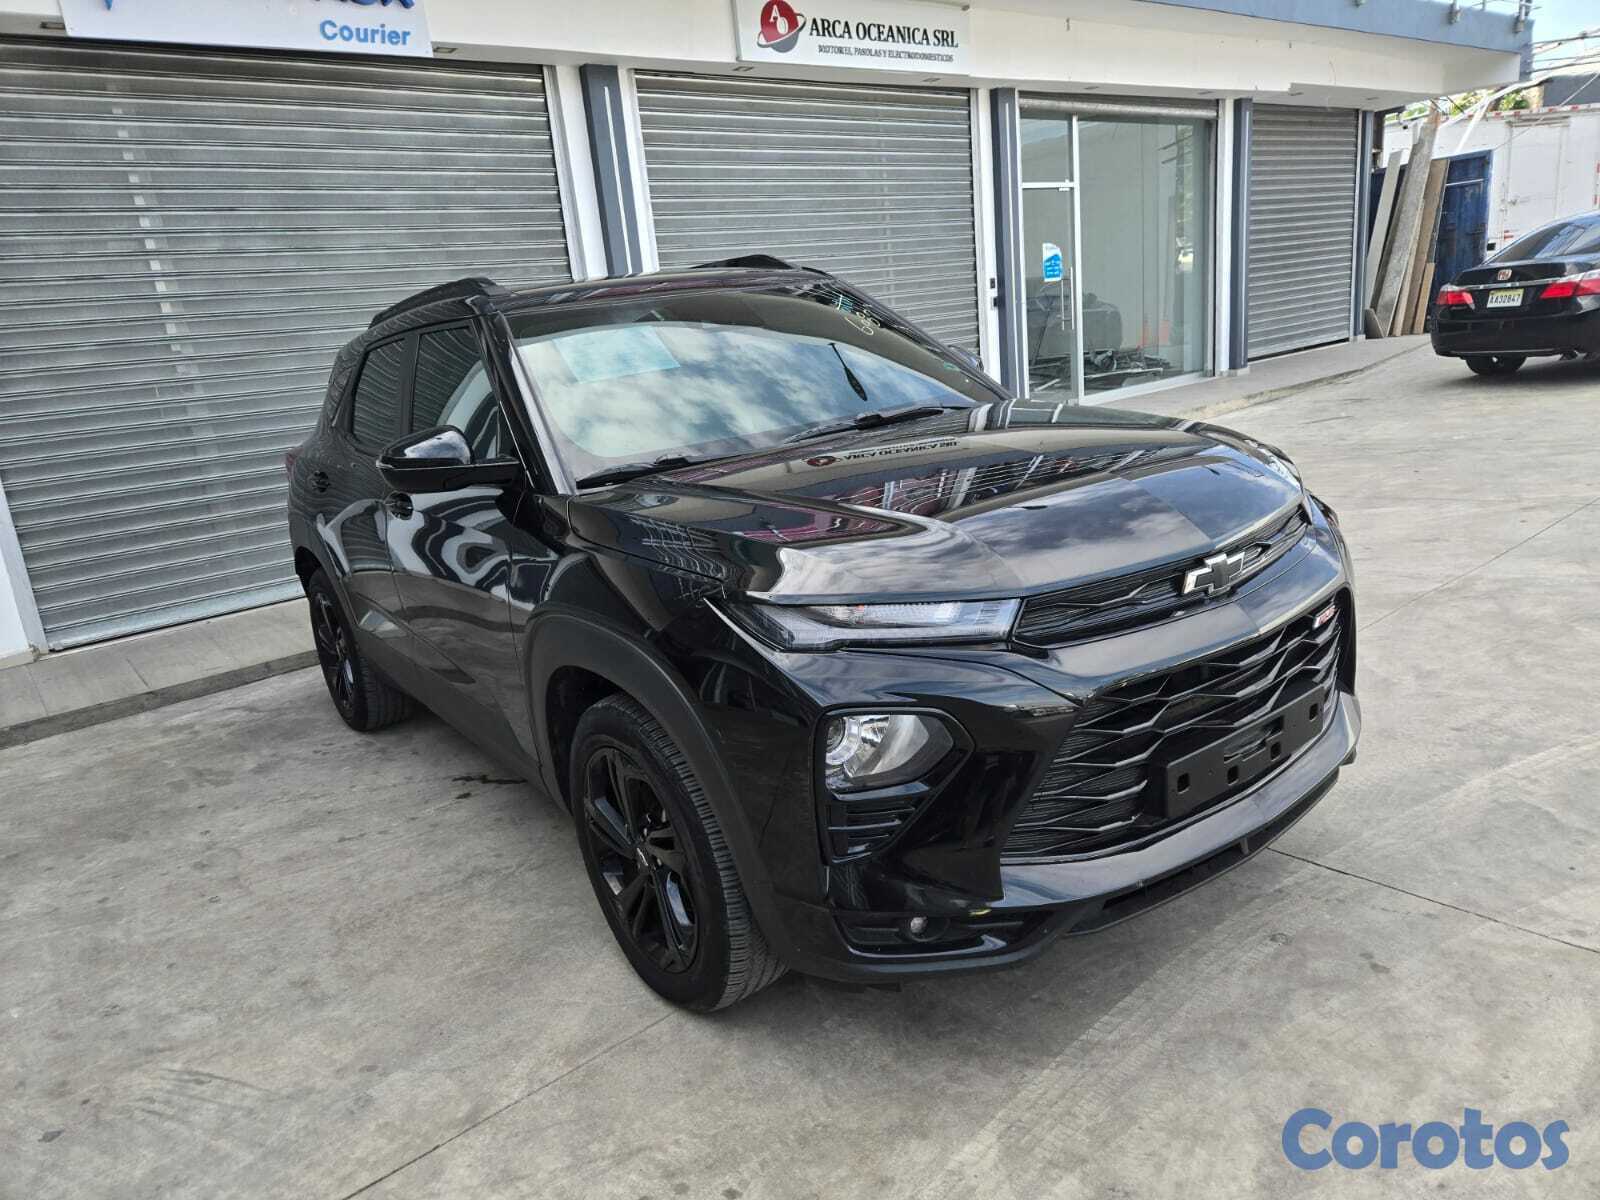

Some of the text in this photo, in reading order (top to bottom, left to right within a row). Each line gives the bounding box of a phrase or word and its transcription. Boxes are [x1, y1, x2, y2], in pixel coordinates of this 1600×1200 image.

[319, 19, 411, 46] Courier
[809, 17, 959, 49] ARCA OCEANICA SRL
